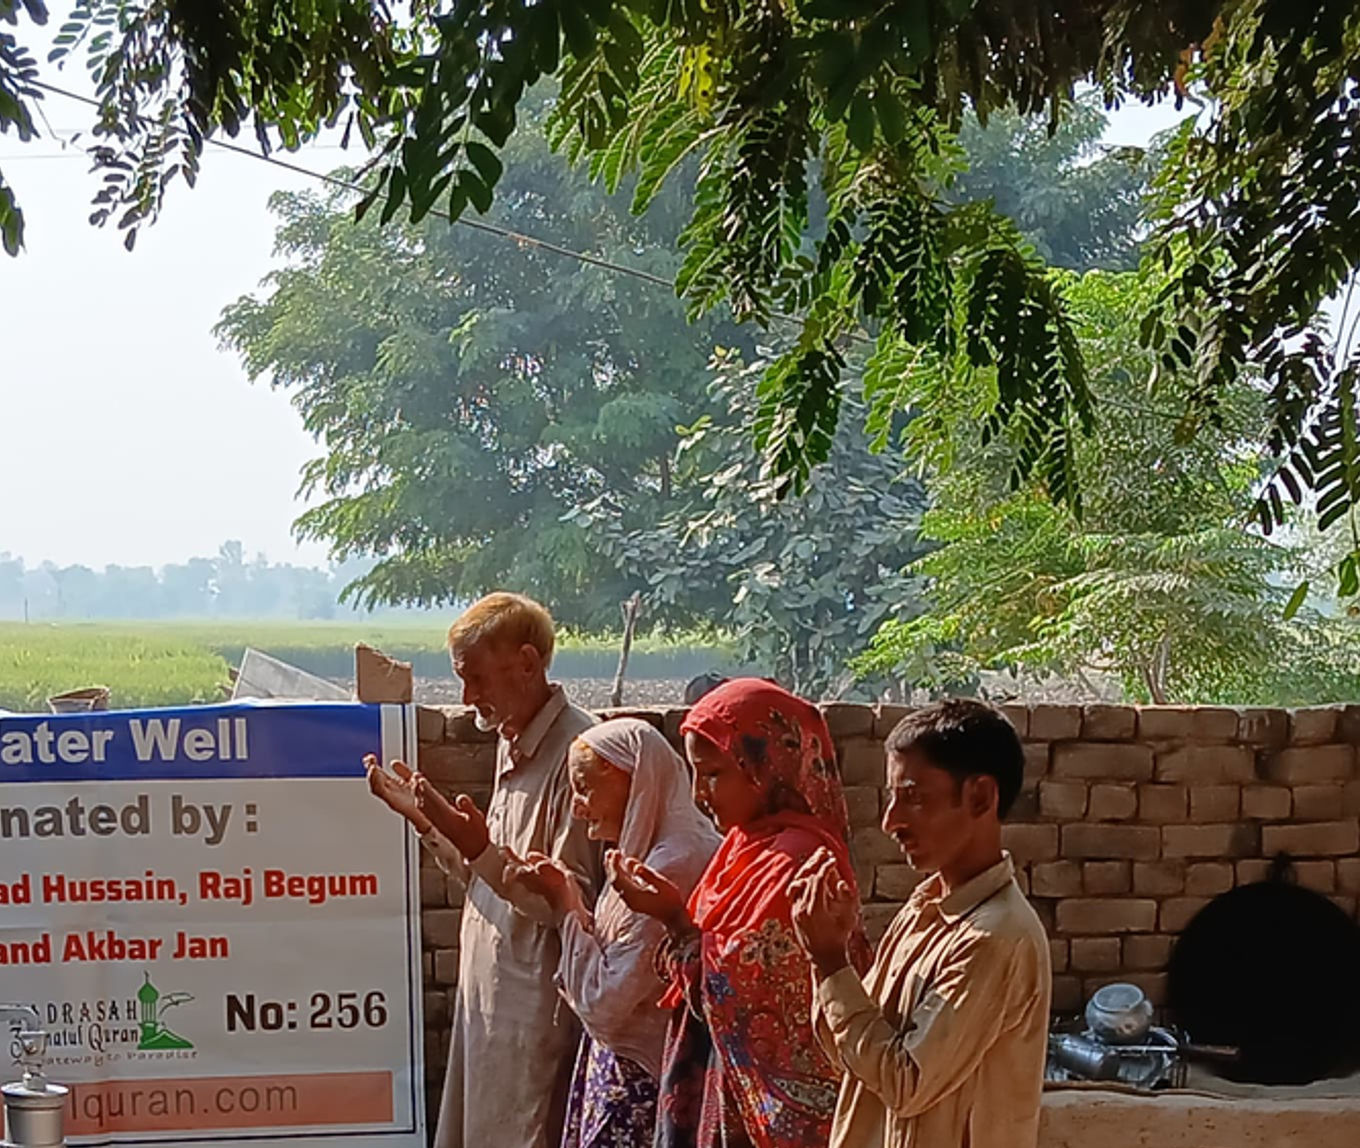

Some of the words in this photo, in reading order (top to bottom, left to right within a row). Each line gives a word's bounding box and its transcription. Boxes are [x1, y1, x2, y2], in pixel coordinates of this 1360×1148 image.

[129, 717, 249, 761] Well
[42, 870, 188, 906] Hussain,
[198, 867, 253, 906] Raj
[263, 869, 378, 905] Begum
[62, 929, 163, 963] Akbar
[172, 931, 229, 960] Jan
[226, 993, 298, 1032] No:
[309, 990, 388, 1029] 256
